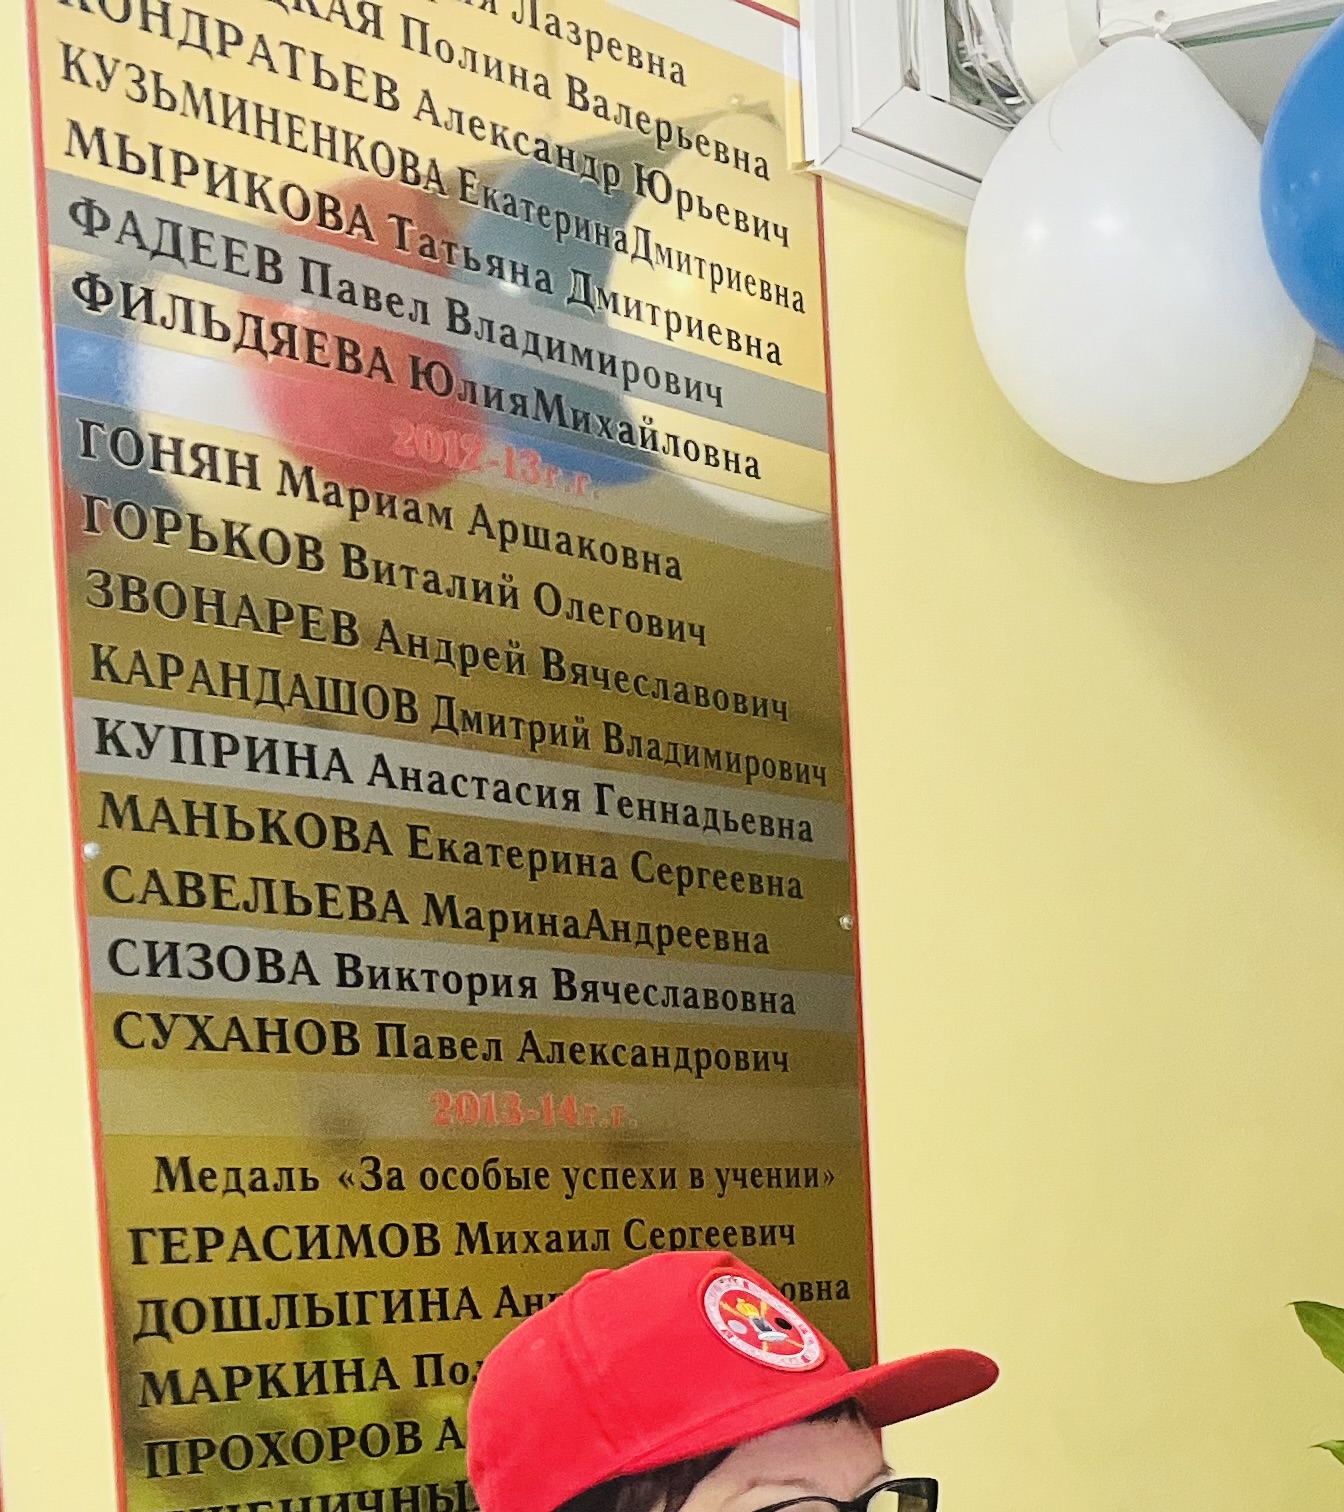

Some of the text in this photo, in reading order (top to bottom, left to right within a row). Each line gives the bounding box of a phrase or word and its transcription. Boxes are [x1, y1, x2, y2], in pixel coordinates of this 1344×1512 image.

[60, 42, 447, 195] КУЗЬМИНЕНКОВА
[400, 14, 551, 99] Полина
[566, 74, 770, 181] Валерьевна
[414, 90, 619, 195] Александр
[634, 163, 788, 247] Юрьевич
[65, 119, 782, 365] МЫРИКОВА Татьяна Дмитриевна
[69, 197, 722, 408] ФАДЕЕВ Павел Владимирович
[72, 272, 394, 383] ФИЛЬДЯЕВА
[79, 419, 682, 580] ГОНЯН Мариам Аршаковна
[83, 495, 705, 646] ГОРЬКОВ Виталий Олегович
[87, 570, 788, 722] ЗВОНАРЕВ Андрей Вячеславович
[91, 643, 826, 787] КАРАНДАШОВ Дмитрий Владимирович
[93, 717, 813, 842] КУПРИНА Анастасия Геннадьевна
[97, 791, 804, 899] МАНЬКОВА Екатерина Сергеевна
[103, 865, 409, 924] САВЕЛЬЕВА
[108, 939, 796, 1015] СИЗОВА Виктория Вячеславовна
[114, 1011, 789, 1079] СУХАНОВ Павел Александрович
[152, 1156, 834, 1199] Медаль «За особые успехи в учении»
[127, 1219, 794, 1265] ГЕРАСИМОВ Михаил Сергеевич
[133, 1286, 482, 1344] ДОШЛЫГИНА
[138, 1357, 400, 1407] МАРКИНА
[145, 1421, 422, 1479] ПРОХОРОВ
